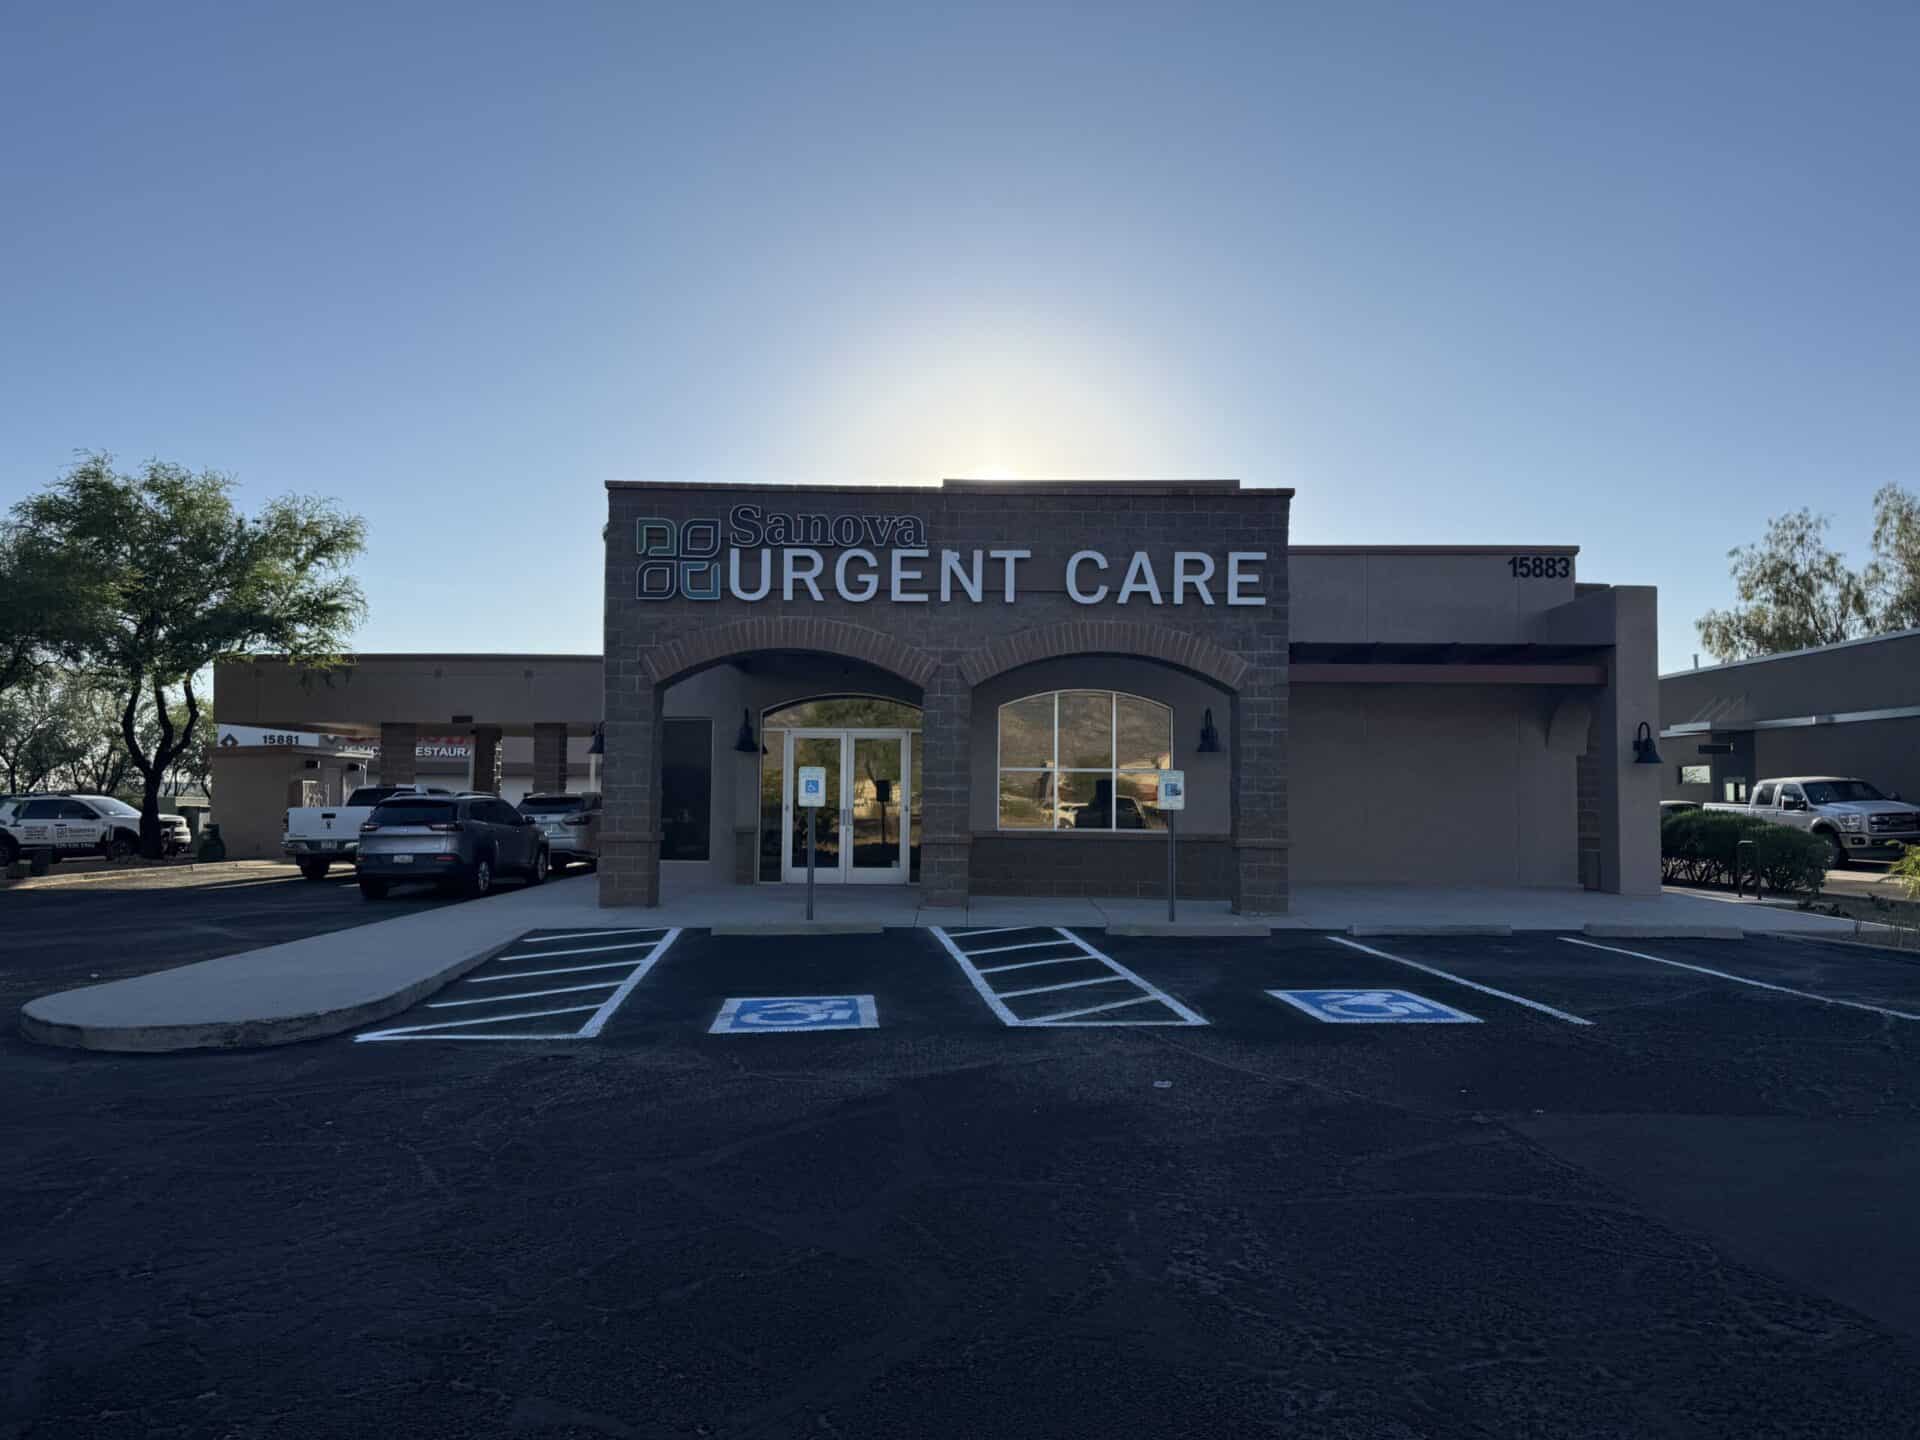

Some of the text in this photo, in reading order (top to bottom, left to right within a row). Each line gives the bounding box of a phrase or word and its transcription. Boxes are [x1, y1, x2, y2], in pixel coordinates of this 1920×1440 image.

[729, 504, 928, 549] Sanova
[729, 548, 1268, 606] URGENT CARE
[1508, 557, 1570, 578] 15883
[262, 734, 299, 745] 15881
[415, 746, 471, 757] ESTAUR
